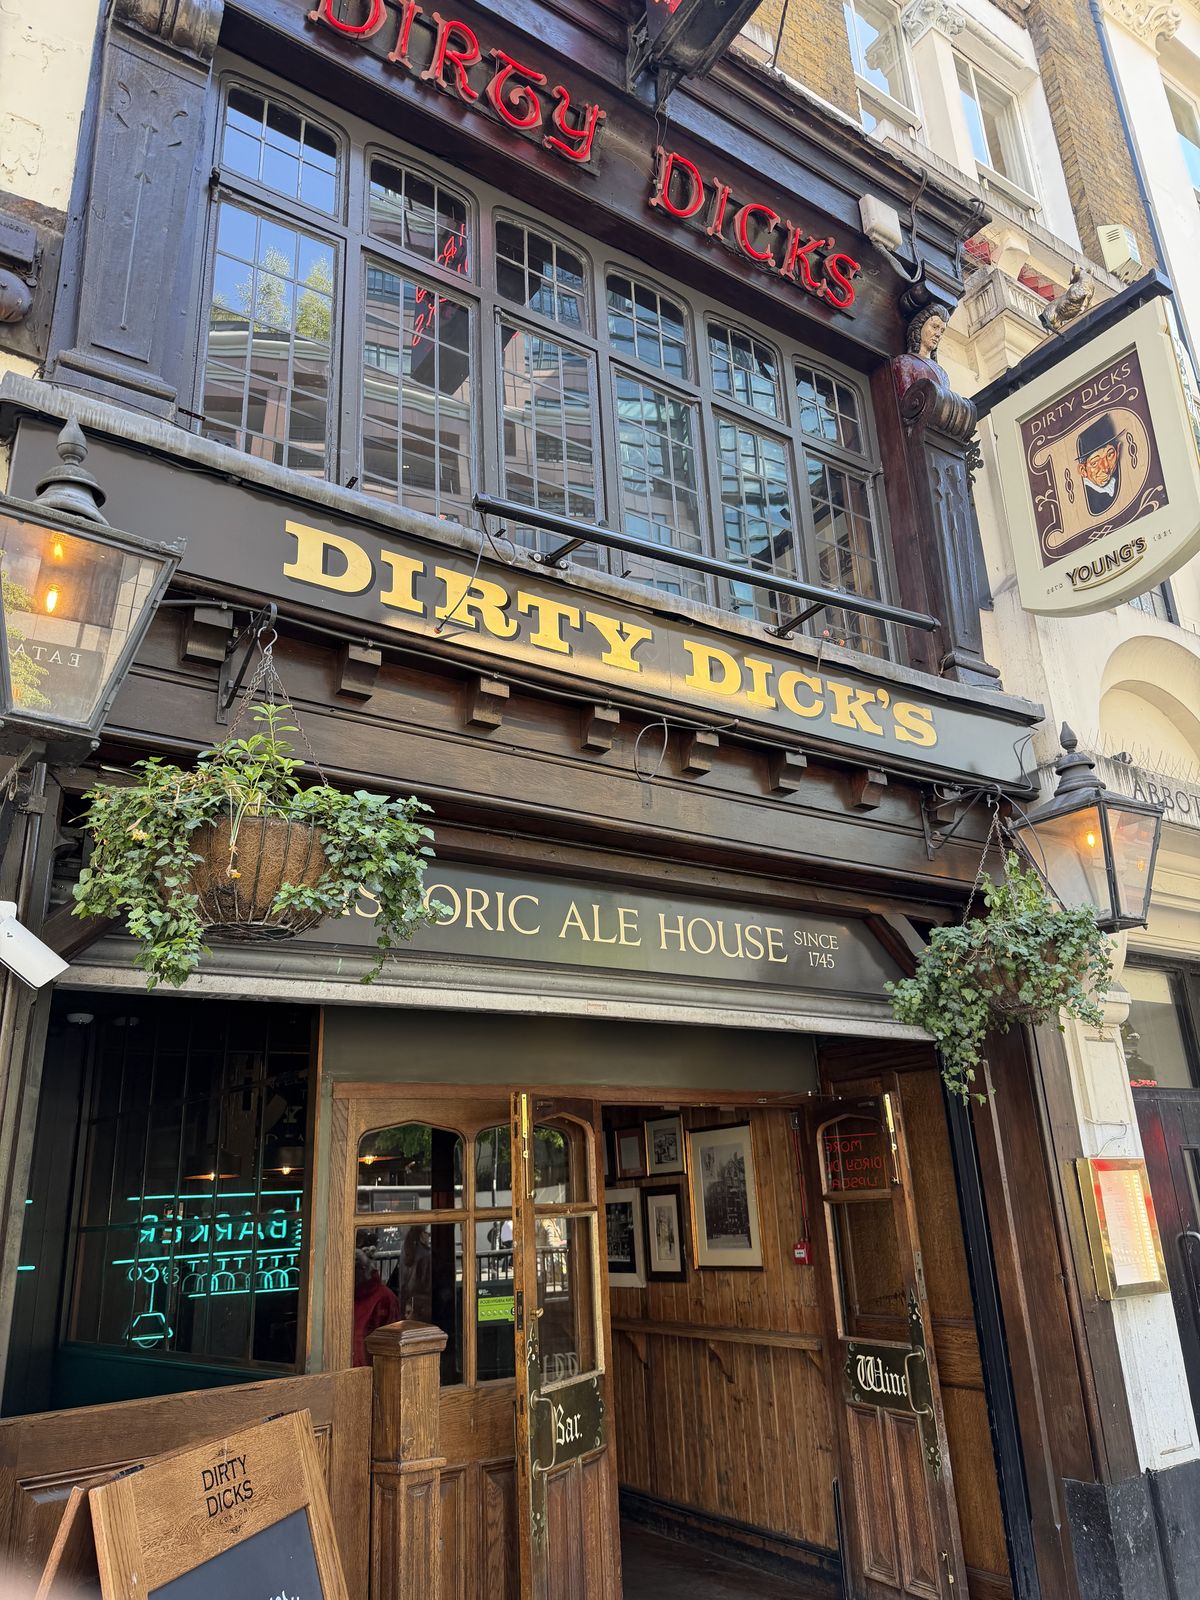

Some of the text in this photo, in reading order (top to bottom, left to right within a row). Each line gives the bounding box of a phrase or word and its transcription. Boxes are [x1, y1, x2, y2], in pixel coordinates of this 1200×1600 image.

[1031, 362, 1131, 436] DIRTY DICKS
[1065, 537, 1148, 586] YOUNG'S
[283, 520, 939, 747] DIRTY DICK'S
[558, 901, 642, 947] ALE
[658, 913, 789, 963] HOUSE
[793, 930, 839, 951] SINCE
[808, 951, 835, 969] 1745
[201, 1454, 247, 1492] DIRTY
[206, 1479, 254, 1518] DICKS
